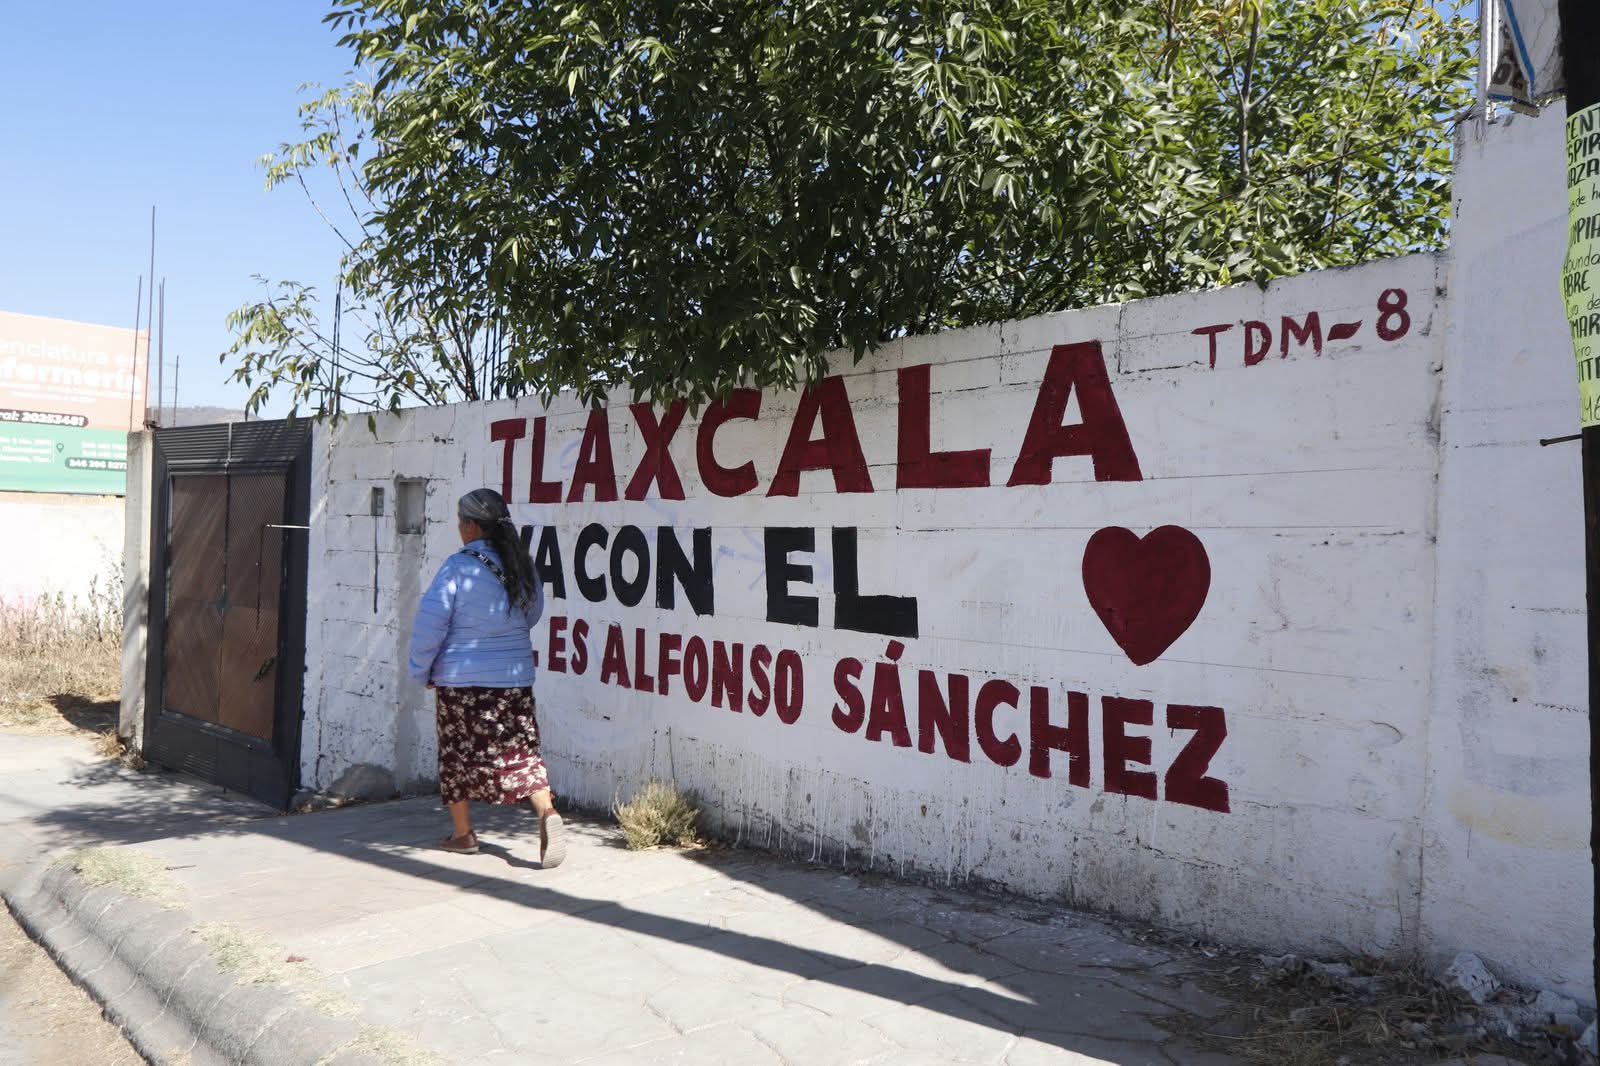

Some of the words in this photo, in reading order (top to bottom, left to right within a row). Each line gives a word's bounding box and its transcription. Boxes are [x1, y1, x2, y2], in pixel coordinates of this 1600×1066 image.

[490, 340, 1142, 504] TLAXCALA
[764, 526, 919, 639] EL
[600, 623, 804, 725] ALFONSO
[831, 639, 1231, 813] SÁNCHEZ
